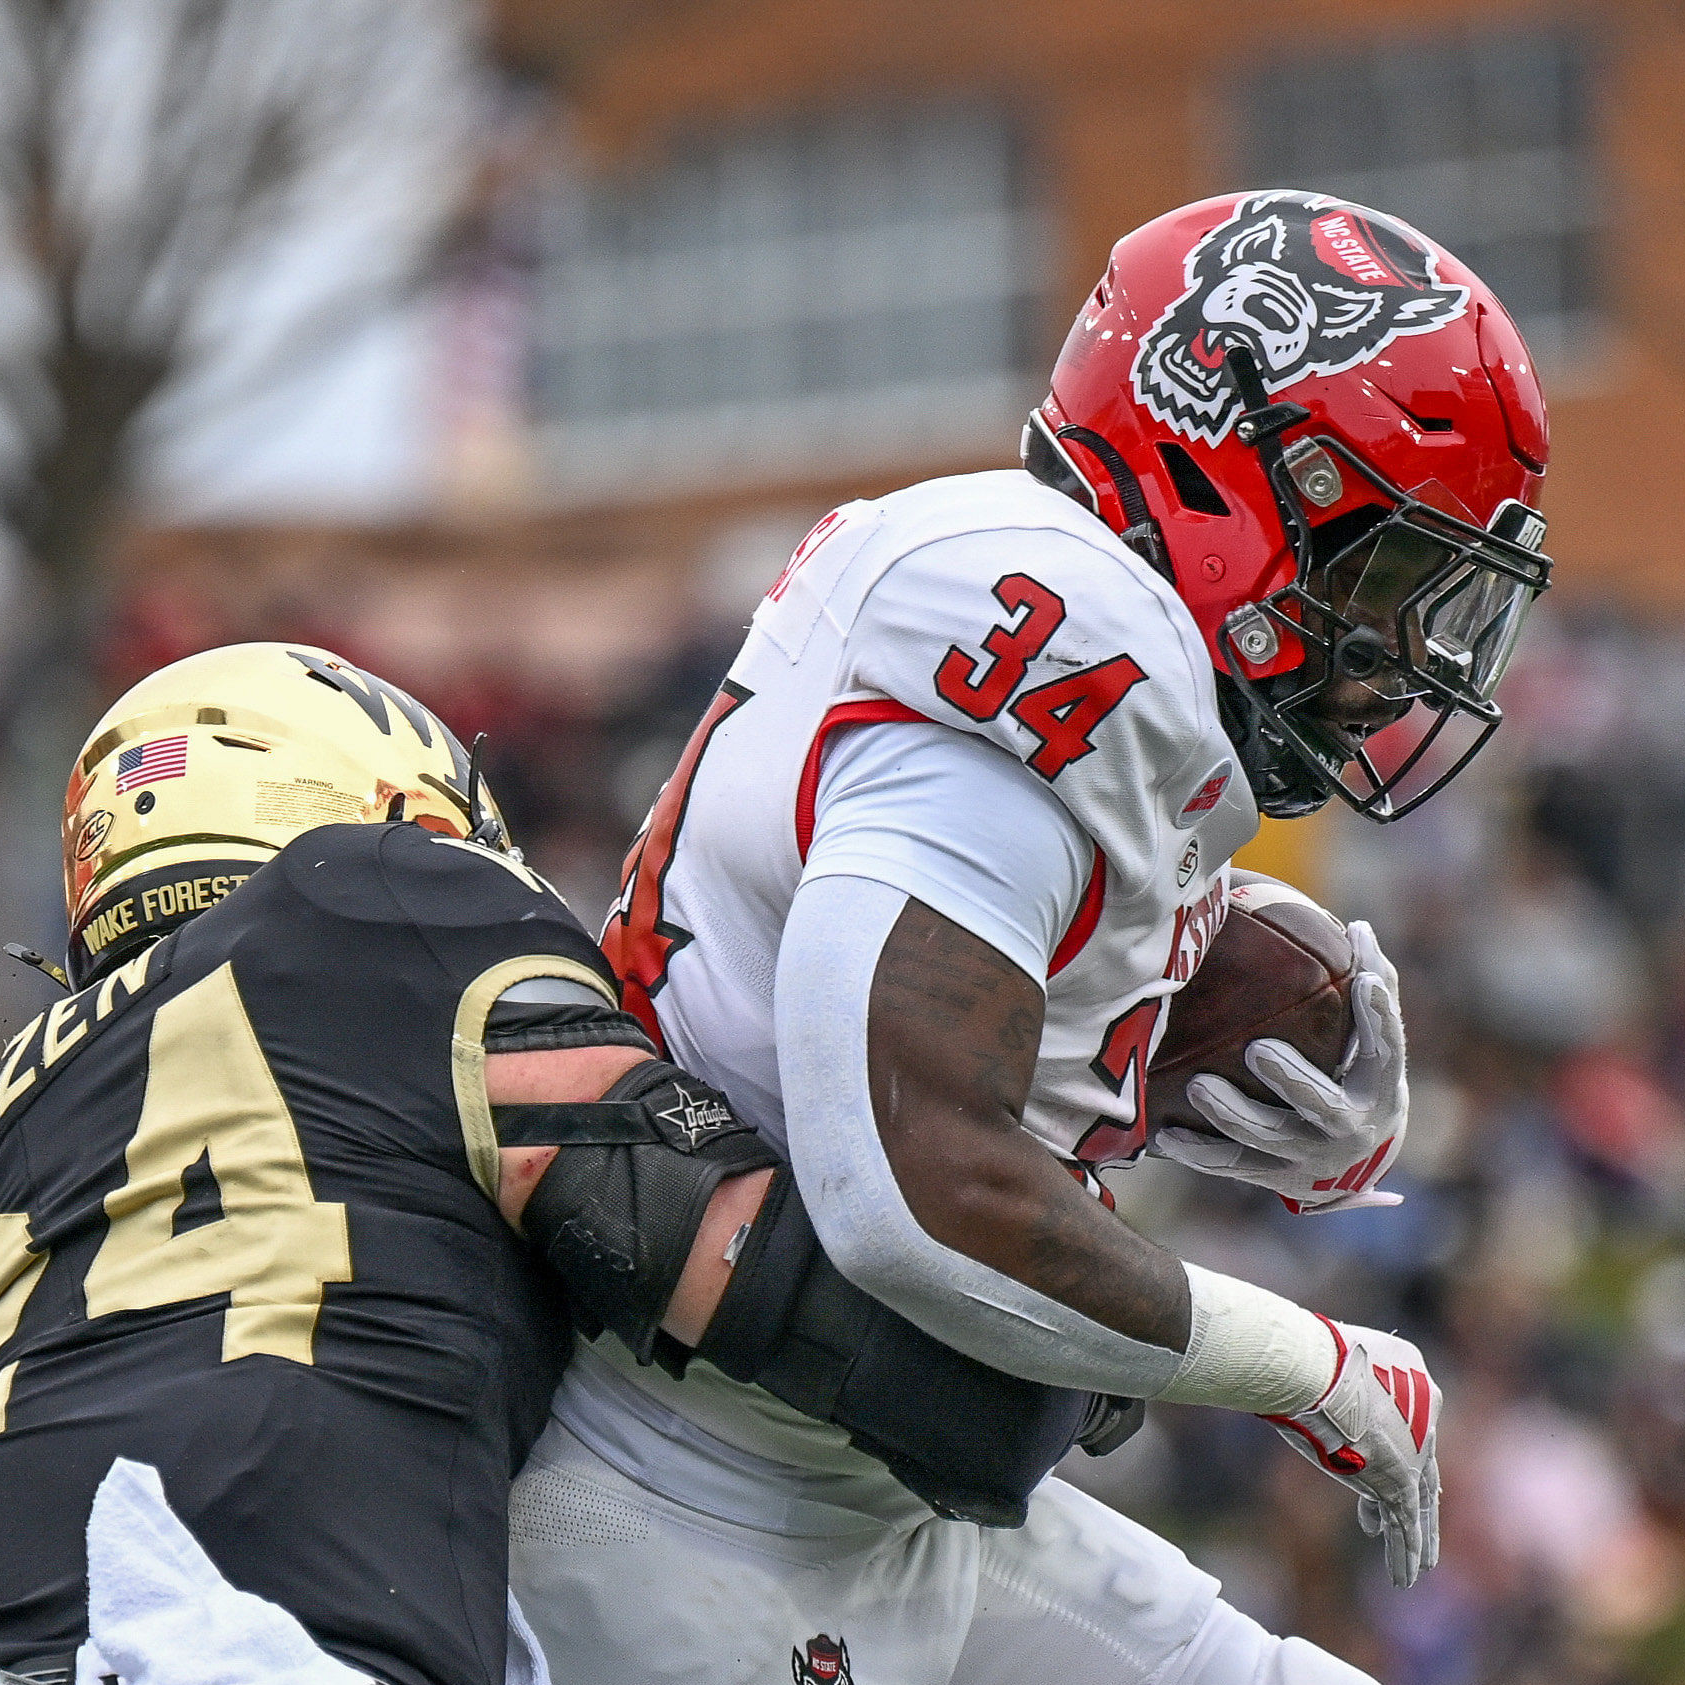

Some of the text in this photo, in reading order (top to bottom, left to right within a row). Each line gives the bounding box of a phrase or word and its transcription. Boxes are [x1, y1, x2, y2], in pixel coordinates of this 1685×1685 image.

[1318, 216, 1388, 281] NC STATE
[933, 572, 1150, 784] 34
[294, 777, 334, 790] WARNING
[82, 813, 106, 843] ACC
[82, 898, 139, 956] WAKE
